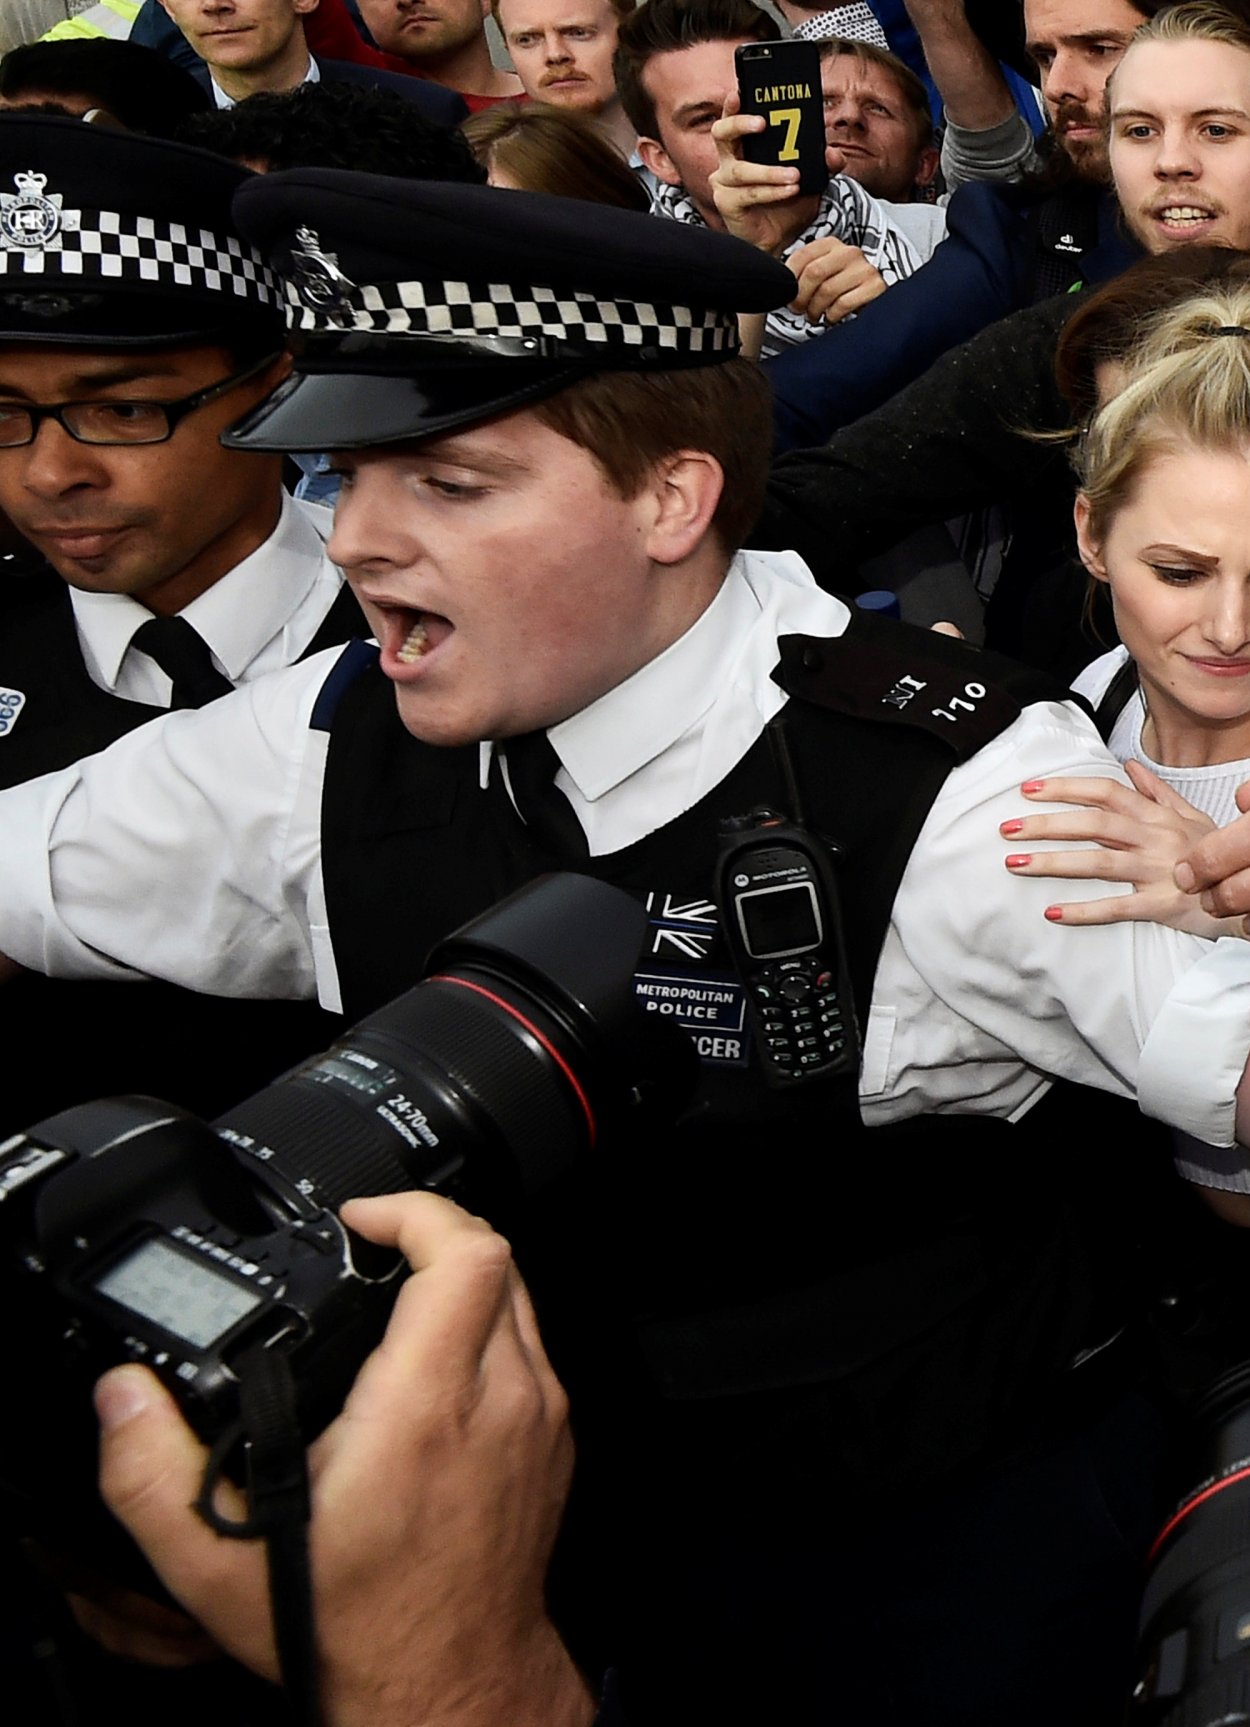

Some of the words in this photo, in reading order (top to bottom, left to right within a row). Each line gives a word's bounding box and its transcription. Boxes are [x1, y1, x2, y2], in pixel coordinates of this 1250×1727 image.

[755, 83, 811, 103] CANTONA
[769, 108, 801, 161] 7
[752, 866, 807, 881] MOTOROLA
[635, 983, 735, 1004] METROPOLITAN
[646, 1001, 719, 1019] POLICE
[387, 1094, 440, 1148] 24-70mm
